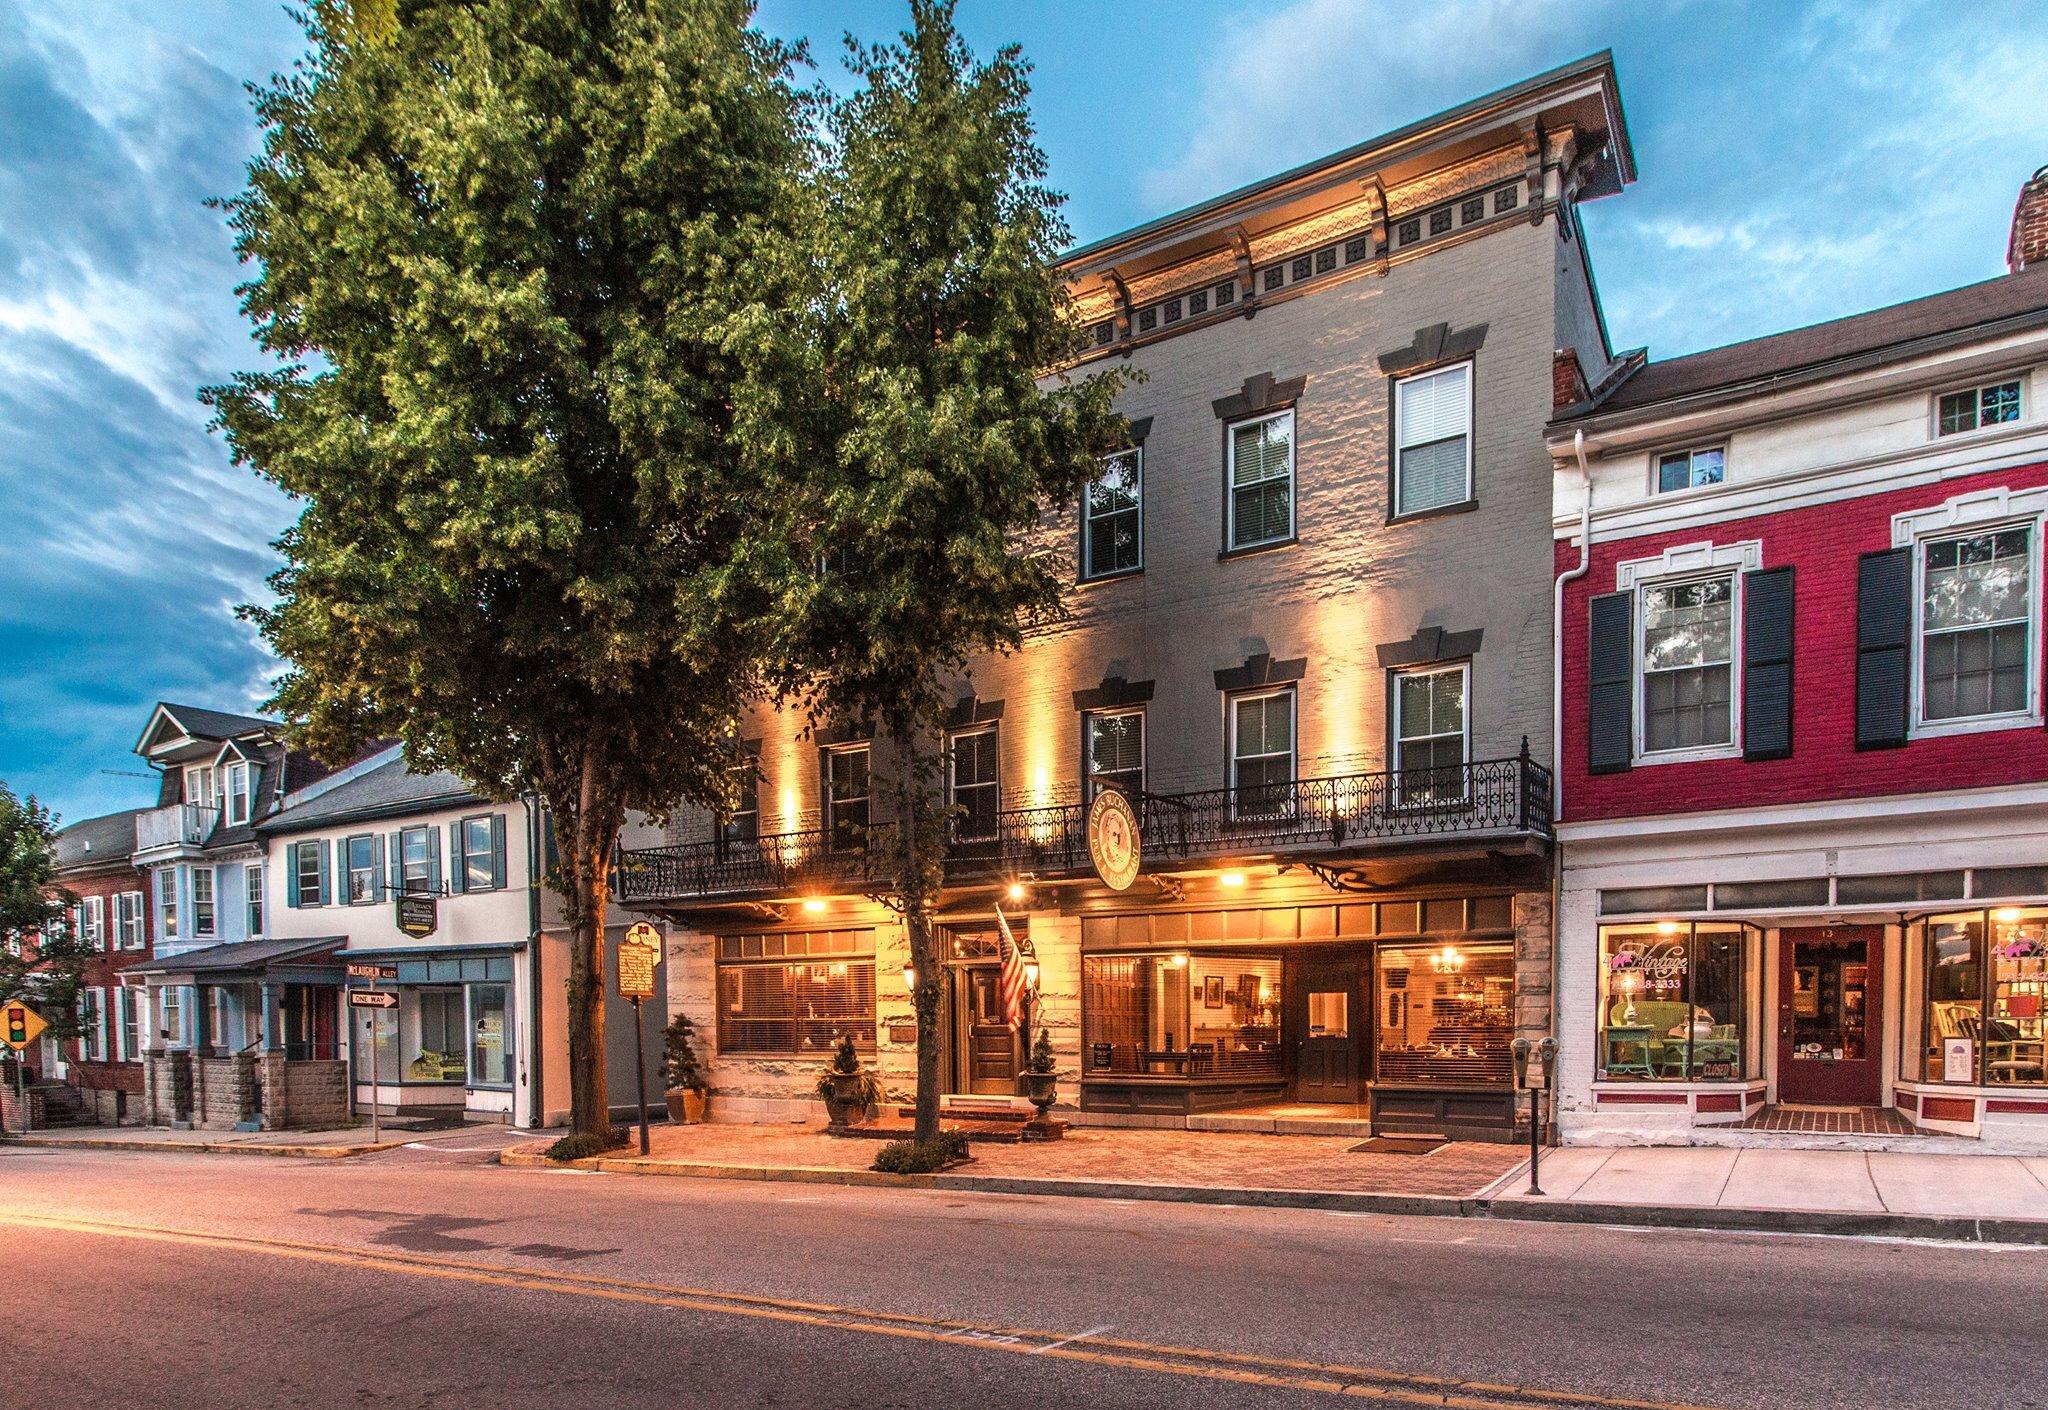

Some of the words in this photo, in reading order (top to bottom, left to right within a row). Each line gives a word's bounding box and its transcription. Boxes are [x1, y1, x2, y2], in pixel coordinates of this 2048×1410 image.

[1105, 794, 1138, 836] BUCHANAN
[1091, 838, 1102, 864] PUB
[1109, 846, 1139, 887] RESTAURANT
[1822, 930, 1833, 938] 13
[1618, 938, 1688, 980] Vintage
[382, 970, 397, 978] ALLEY
[355, 995, 368, 1003] ONE
[1704, 1062, 1729, 1077] CLOSED
